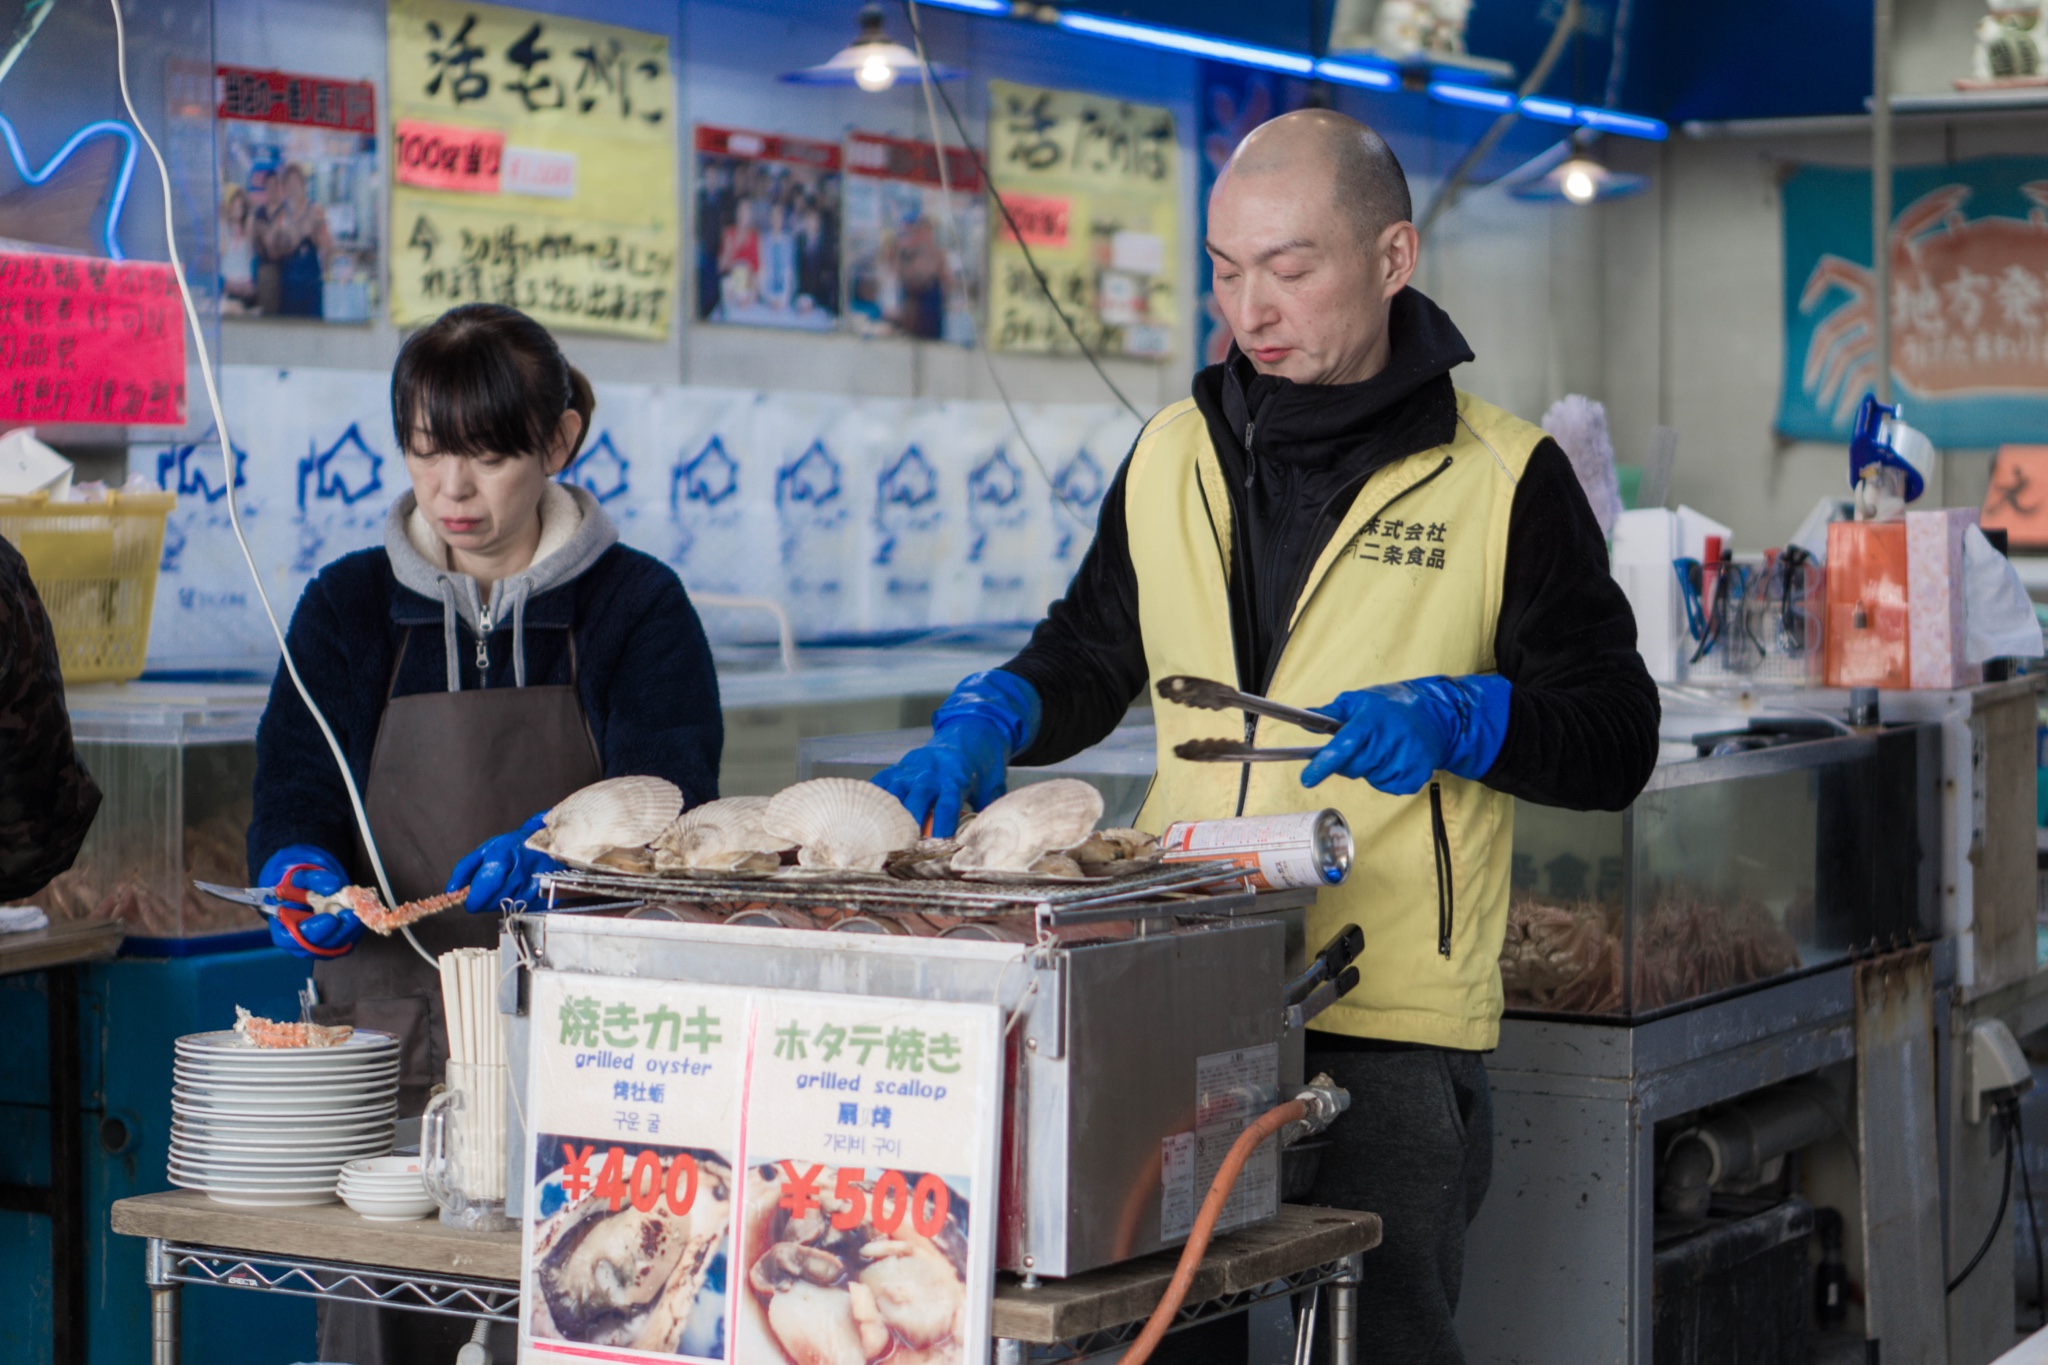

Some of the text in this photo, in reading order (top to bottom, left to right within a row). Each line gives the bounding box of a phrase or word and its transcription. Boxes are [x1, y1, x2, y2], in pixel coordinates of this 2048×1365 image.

[1891, 262, 2048, 332] 地方発
[1361, 519, 1447, 543] 株式会社
[1359, 543, 1446, 570] 二条食品
[559, 995, 722, 1054] 焼きカキ
[773, 1018, 962, 1075] ホタテ焼き
[575, 1051, 712, 1076] grilled oyster
[796, 1071, 947, 1101] grilled scallop
[613, 1110, 661, 1134] 구운 굴
[823, 1132, 902, 1159] 가리비 구이
[561, 1142, 699, 1217] ¥400
[778, 1159, 949, 1239] ¥500
